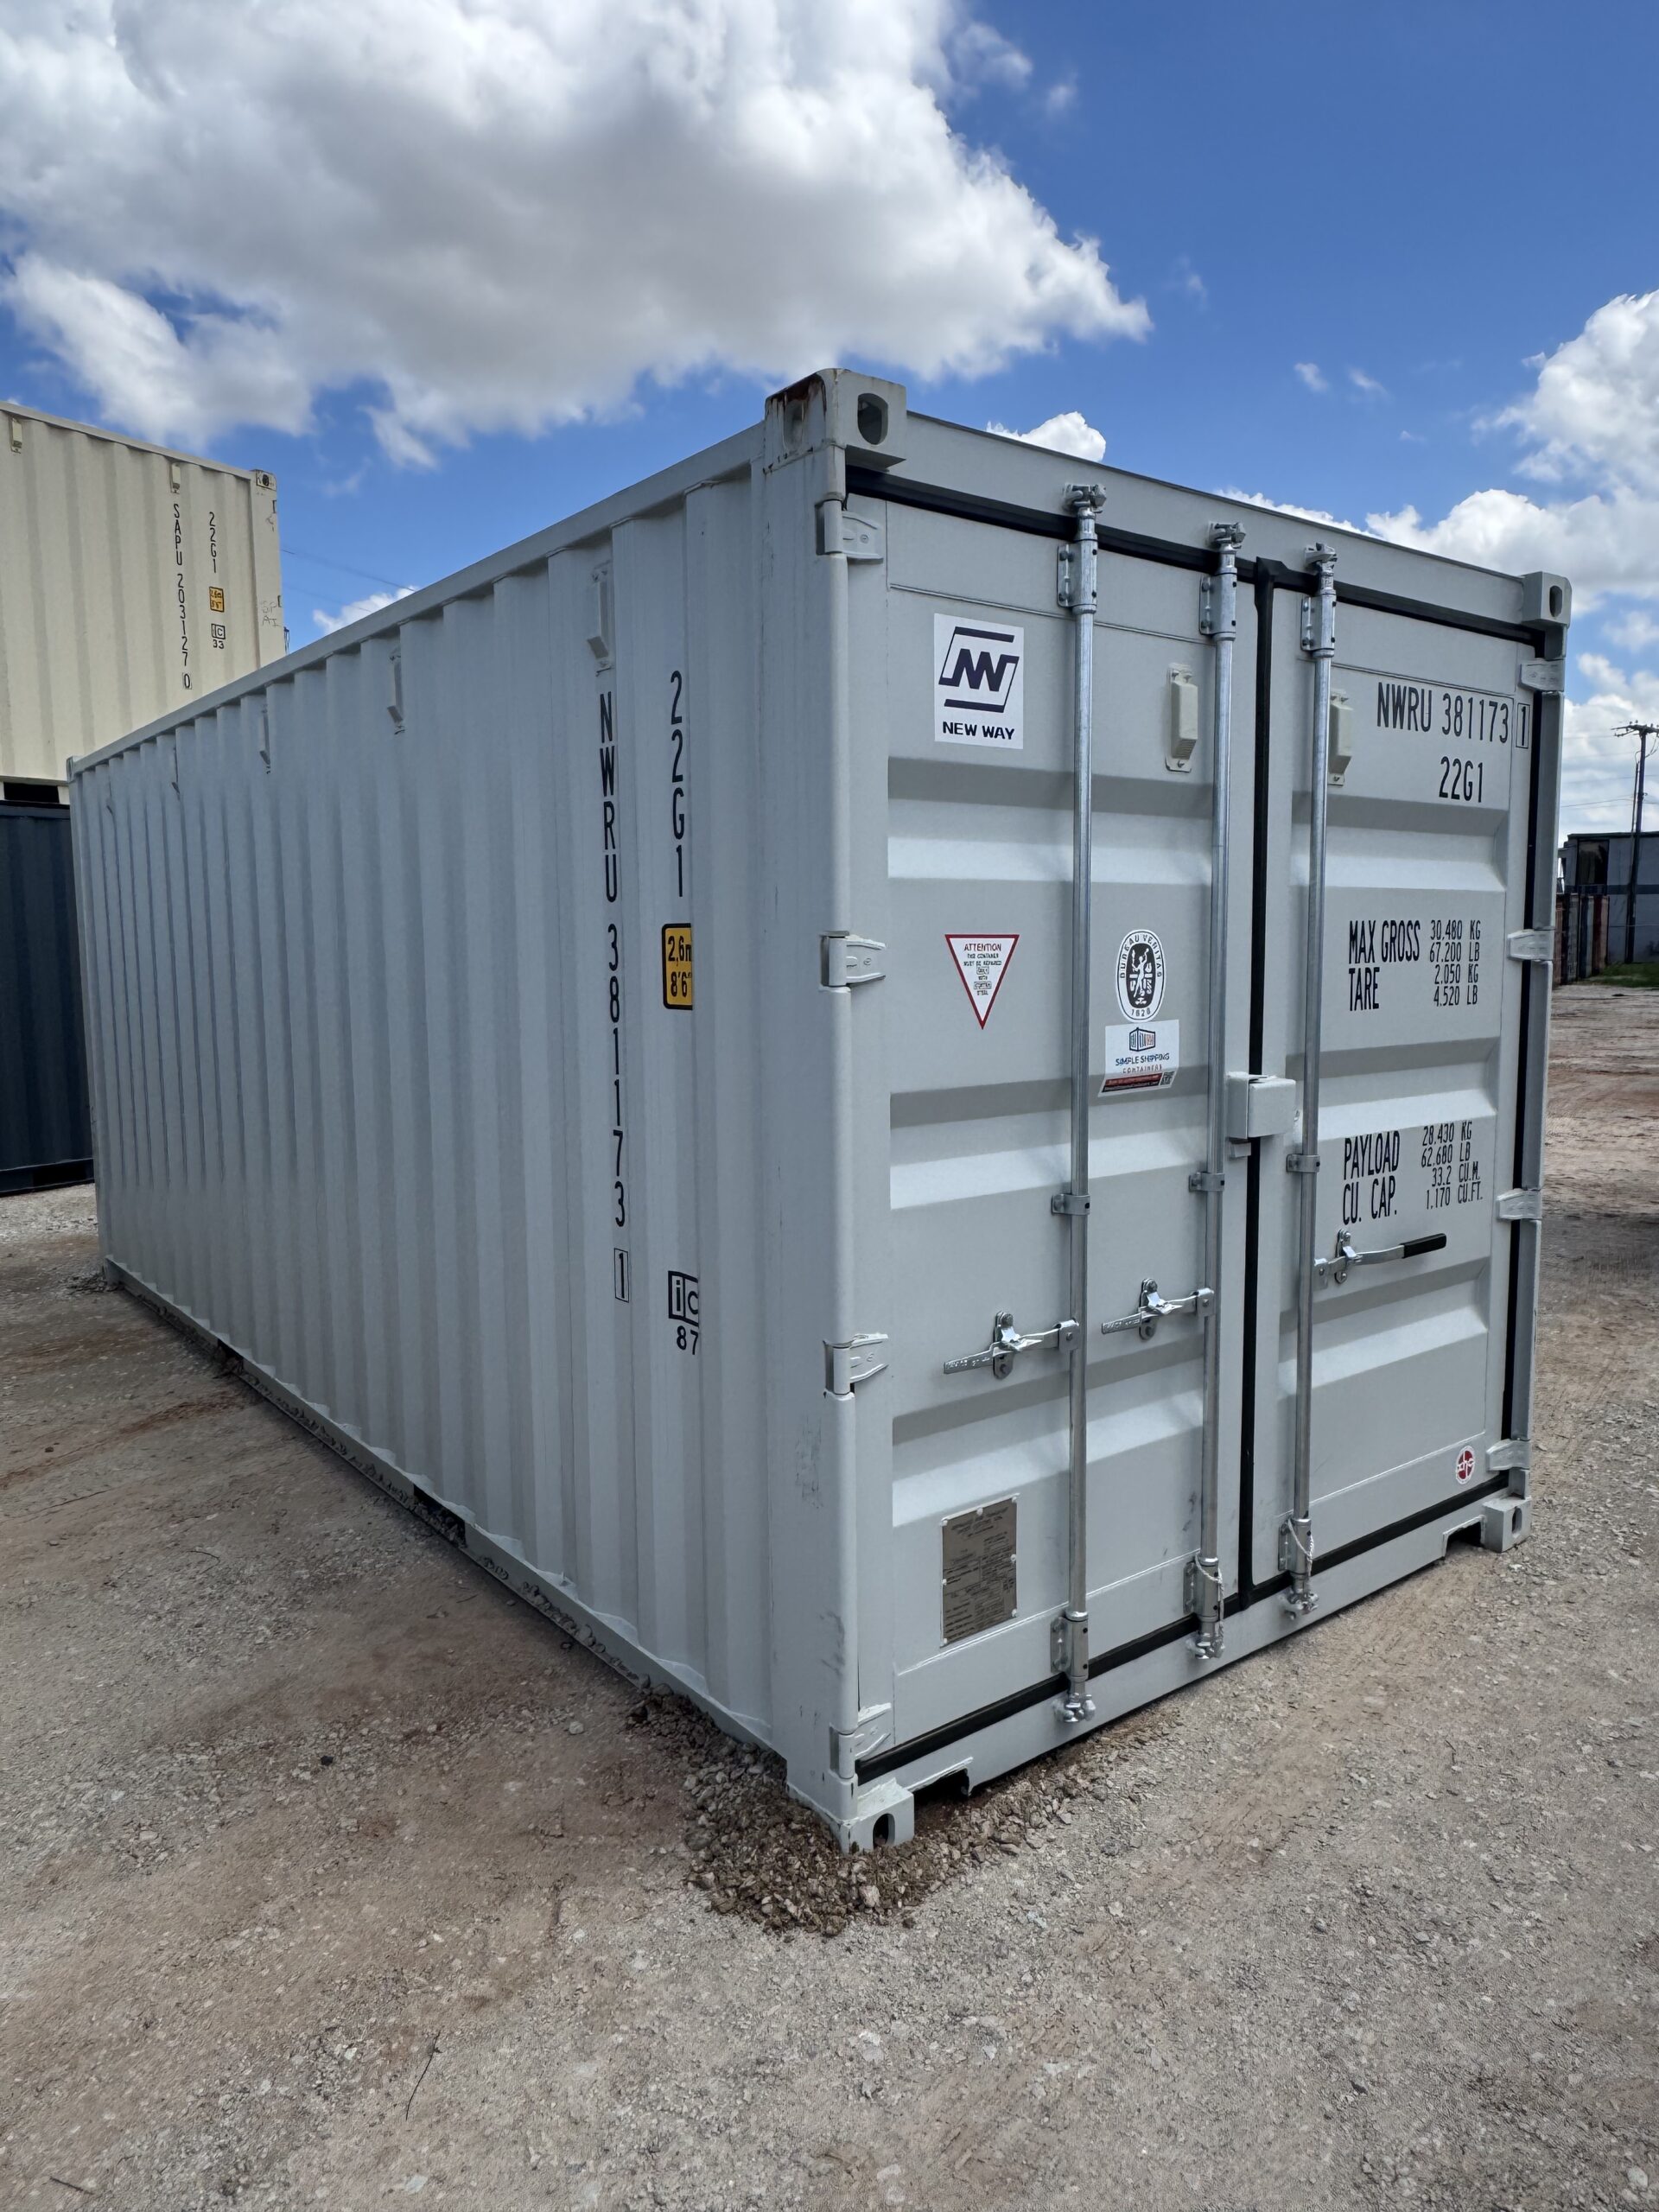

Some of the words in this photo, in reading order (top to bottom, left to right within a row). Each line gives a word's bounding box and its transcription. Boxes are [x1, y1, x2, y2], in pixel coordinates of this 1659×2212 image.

[174, 504, 182, 566] SAPU
[177, 574, 188, 666] 203127
[213, 639, 225, 649] 33
[943, 721, 977, 736] NEW
[982, 726, 1014, 740] WAY
[1376, 682, 1433, 732] NWRU
[1442, 693, 1509, 743] 381173
[600, 691, 618, 903] NWRU
[671, 671, 684, 897] 22G1
[1439, 756, 1484, 803] 22G1
[1349, 920, 1376, 964] MAX
[1382, 920, 1421, 963] GROSS
[1470, 920, 1481, 940] KG
[1429, 942, 1462, 963] 67.200
[1469, 942, 1480, 963] LB
[1349, 967, 1380, 1011] TARE
[1434, 963, 1461, 984] 2.050
[1468, 963, 1479, 983] KG
[1433, 986, 1460, 1007] 4.520
[1466, 985, 1478, 1005] LB
[608, 924, 626, 1227] 381173
[1344, 1130, 1401, 1180] PAYLOAD
[1422, 1122, 1455, 1147] 28.430
[1461, 1120, 1472, 1141] KG
[1421, 1144, 1453, 1167] 62.680
[1459, 1141, 1471, 1162] LB
[1343, 1181, 1362, 1225] CU.
[1371, 1175, 1397, 1219] CAP.
[1432, 1166, 1452, 1187] 33.2
[1458, 1181, 1484, 1204] CU.FT.
[677, 1325, 698, 1355] 87
